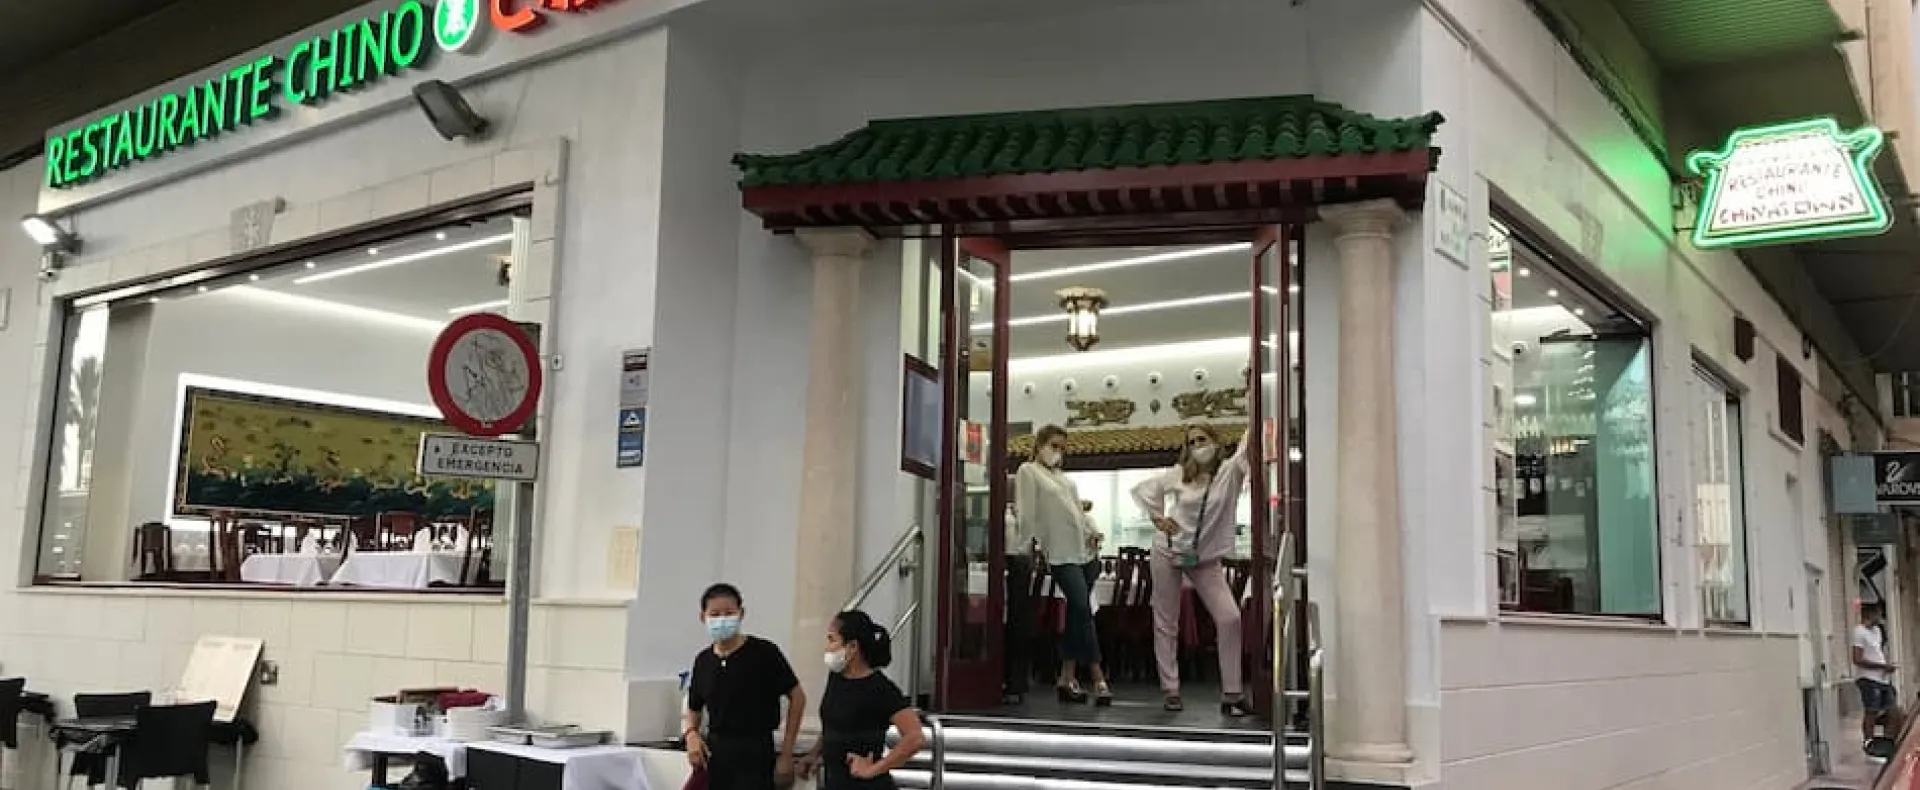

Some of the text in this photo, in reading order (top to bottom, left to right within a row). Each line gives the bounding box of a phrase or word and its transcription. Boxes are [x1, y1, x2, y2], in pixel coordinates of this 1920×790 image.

[48, 55, 274, 186] RESTAURANTE
[285, 0, 424, 103] CHINO
[1728, 162, 1842, 193] RESTAURANTE
[1718, 192, 1855, 226] CHINATOWN
[437, 458, 523, 474] EMERGENCIA
[451, 443, 513, 458] EXCEPTO
